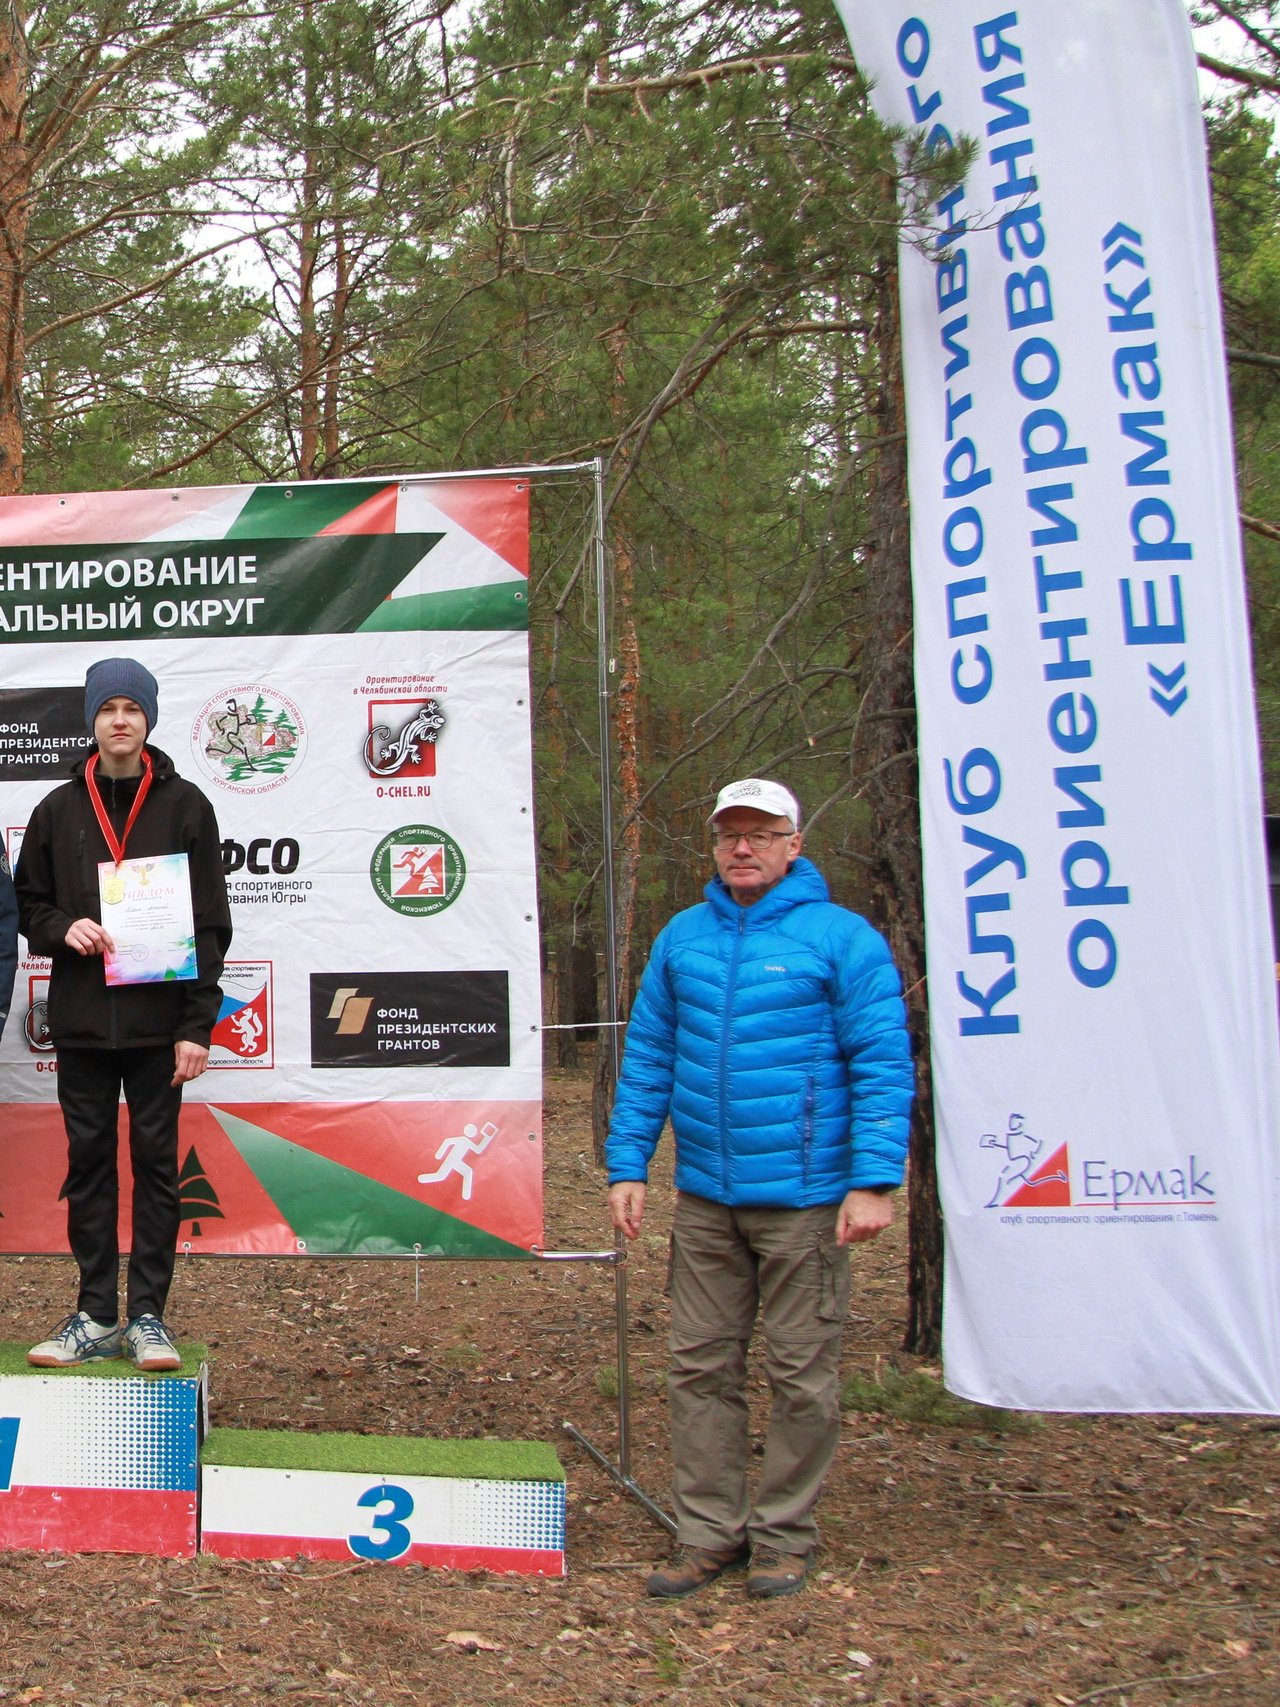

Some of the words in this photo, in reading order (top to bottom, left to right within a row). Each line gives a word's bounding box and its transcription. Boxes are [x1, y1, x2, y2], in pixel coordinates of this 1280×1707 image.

[895, 17, 993, 705] спортивного
[1101, 221, 1193, 717] «Ермак»
[973, 11, 1130, 989] ориентирования
[153, 597, 264, 628] ОКРУГ
[365, 675, 435, 686] Ориентирование
[360, 684, 412, 694] Челябинской
[414, 684, 448, 693] области
[192, 701, 212, 741] ФЕДЕРАЦИЯ
[212, 686, 260, 704] СПОРТИВНОГО
[261, 686, 305, 735] ОРИЕНТИРОВАНИЯ
[0, 723, 39, 735] ФОНД
[0, 736, 95, 749] ПРЕЗИДЕНТСК
[0, 753, 60, 765] ГРАНТОВ
[212, 776, 256, 795] КУРГАНСКОЙ
[257, 775, 289, 793] ОБЛАСТИ
[376, 785, 431, 798] O-CHEL.RU
[398, 828, 446, 842] СПОРТИВНОГО
[220, 837, 300, 875] ФСО
[374, 837, 396, 872] ФЕДЕРАЦИЯ
[445, 844, 462, 901] ОРИЕНТИРОВАНИЯ
[235, 881, 313, 893] спортивного
[375, 877, 395, 904] ОБЛАСТИ
[942, 747, 1026, 1037] Клуб
[271, 891, 307, 905] Югры
[401, 901, 443, 913] ТЮМЕНСКОЙ
[21, 961, 53, 970] Челябин
[377, 1008, 418, 1020] ФОНД
[377, 1023, 496, 1035] ПРЕЗИДЕНТСКИХ
[377, 1039, 440, 1050] ГРАНТОВ
[1082, 1155, 1214, 1210] Ермак
[1000, 1214, 1022, 1225] клуб
[1026, 1214, 1089, 1225] спортивного
[1094, 1212, 1173, 1224] ориентирования
[348, 1484, 415, 1561] 3
